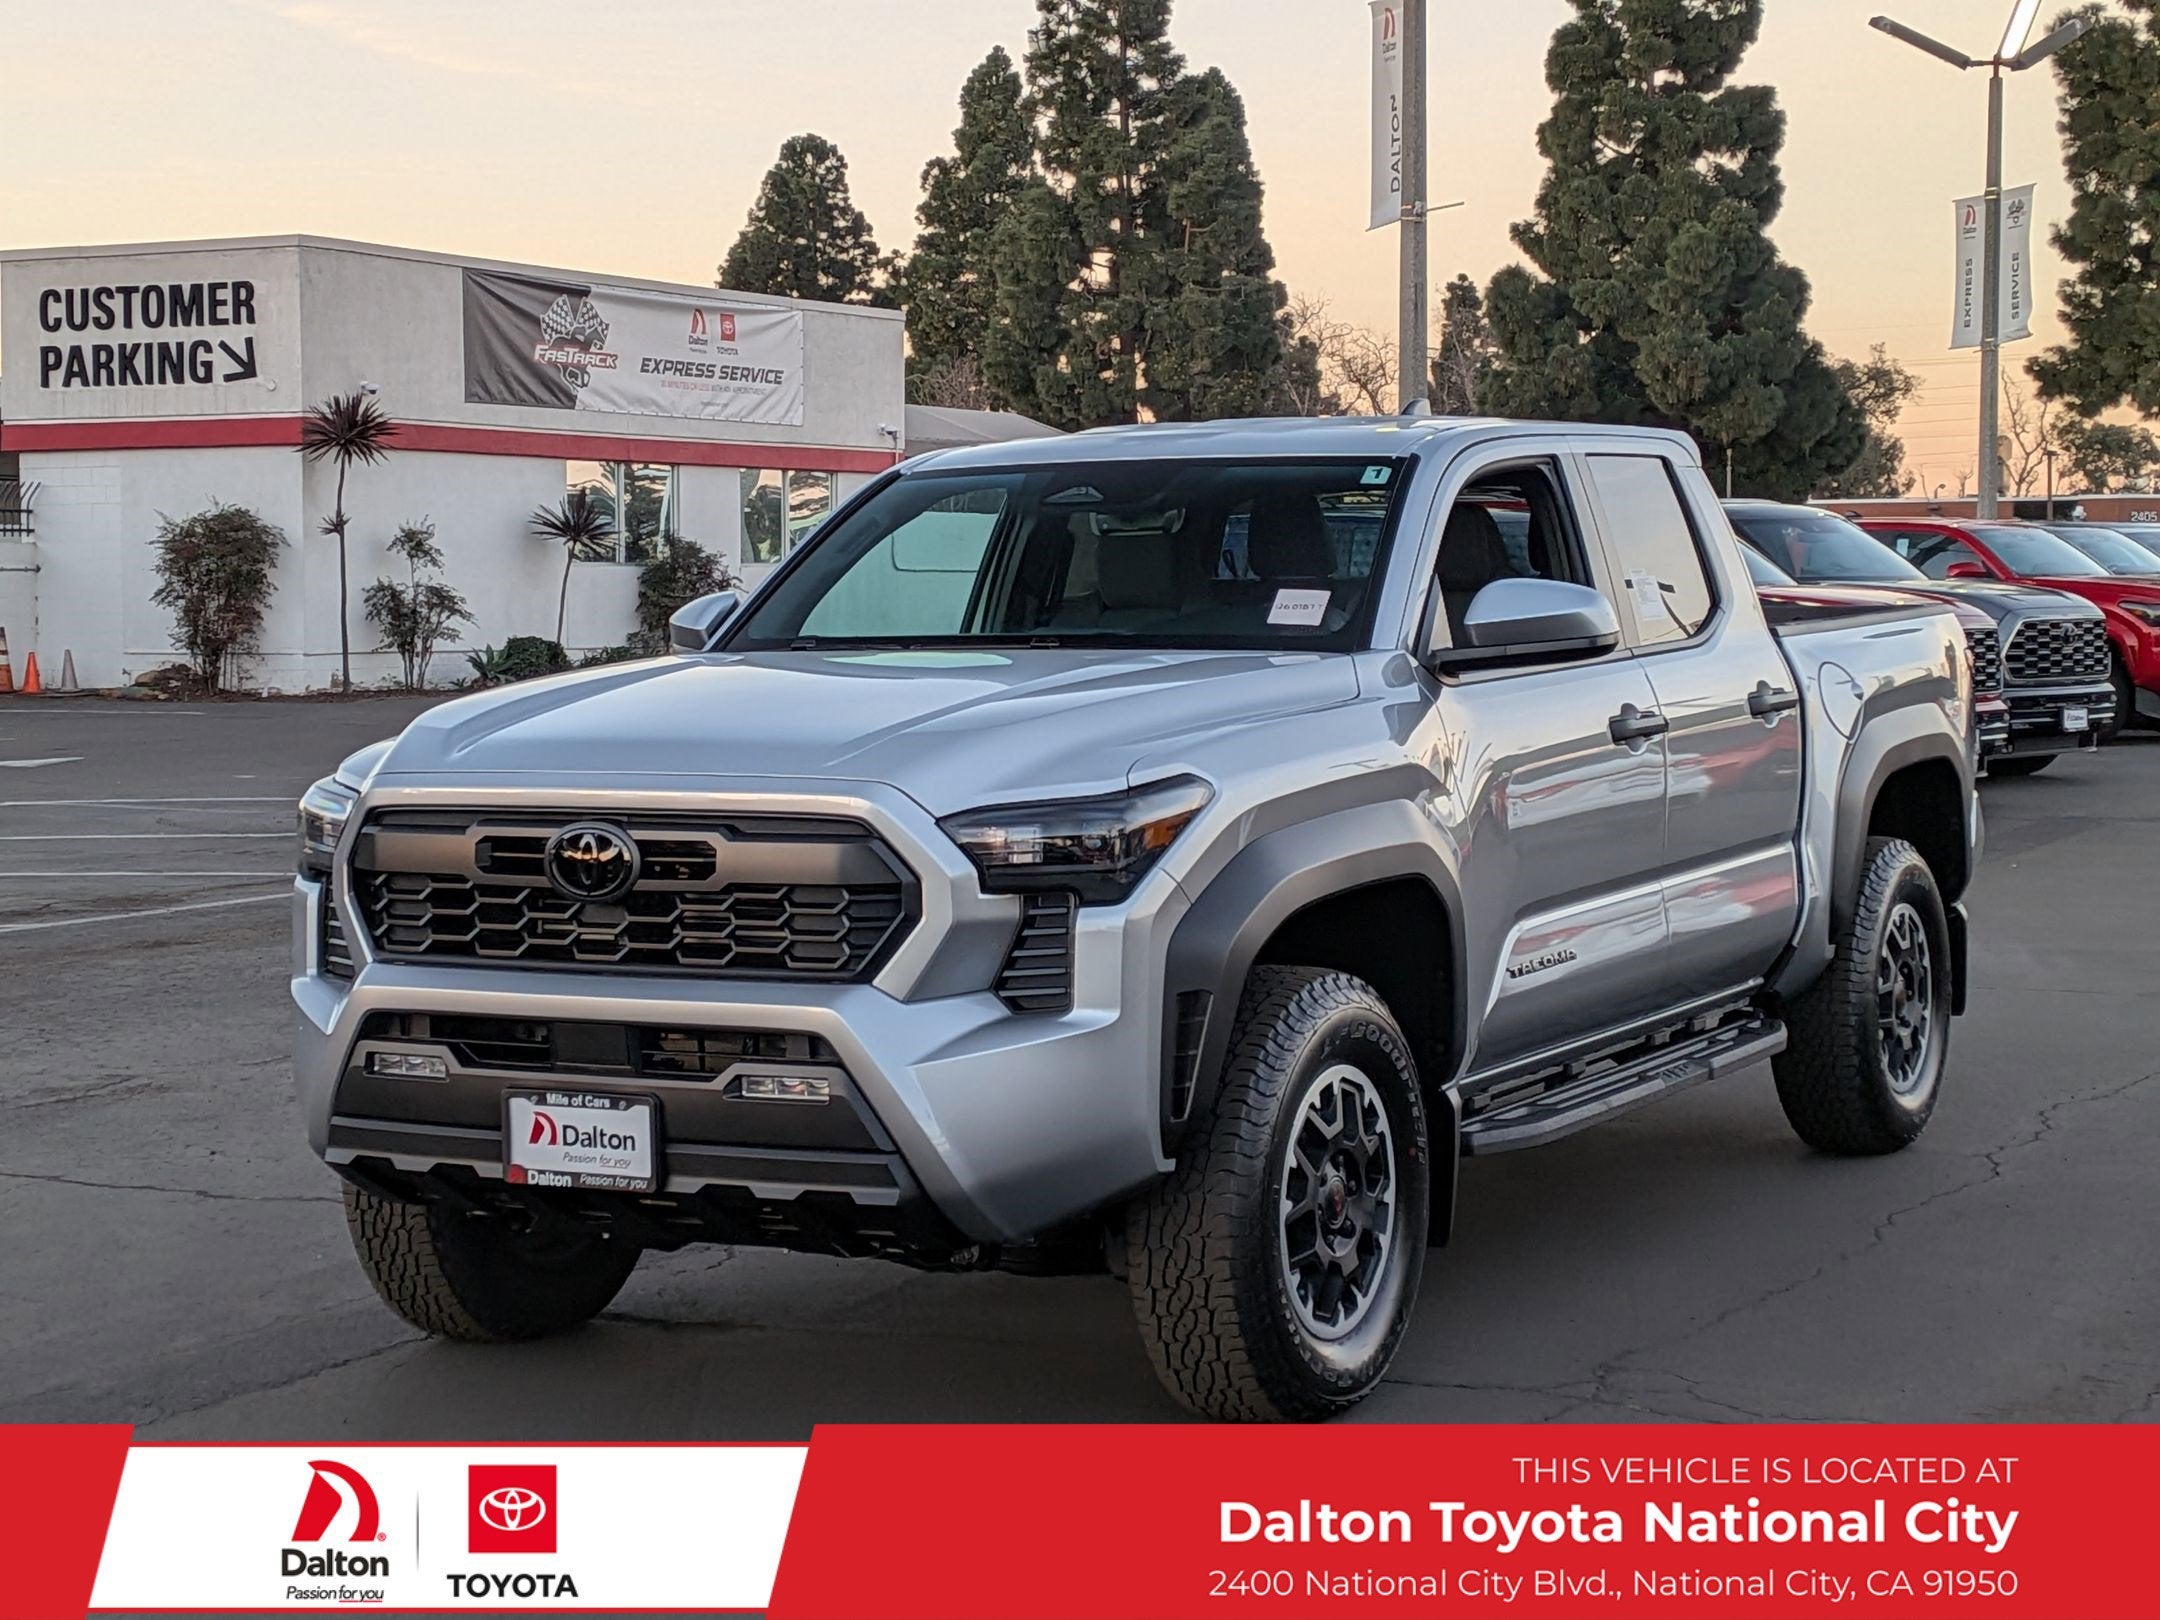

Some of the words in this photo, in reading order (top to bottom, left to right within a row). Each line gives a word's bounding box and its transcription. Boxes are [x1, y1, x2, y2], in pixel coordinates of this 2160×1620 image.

[1390, 94, 1400, 193] DALTON
[1964, 258, 1973, 328] EXPRESS
[2011, 252, 2020, 320] SERVICE
[39, 280, 256, 332] CUSTOMER
[40, 340, 213, 388] PARKING
[640, 357, 717, 379] EXPRESS
[718, 365, 784, 385] SERVICE
[1371, 468, 1383, 479] 1
[2130, 511, 2158, 522] 2405
[1506, 948, 1577, 979] TACOMA
[546, 1093, 569, 1105] Mile
[571, 1095, 583, 1106] of
[584, 1095, 610, 1108] Cars
[562, 1124, 636, 1151] Dalton
[563, 1152, 597, 1165] Passion
[599, 1156, 613, 1166] for
[614, 1158, 631, 1167] you
[528, 1170, 572, 1187] Dalton
[580, 1174, 614, 1187] Passion
[614, 1176, 629, 1187] for
[629, 1180, 648, 1190] you
